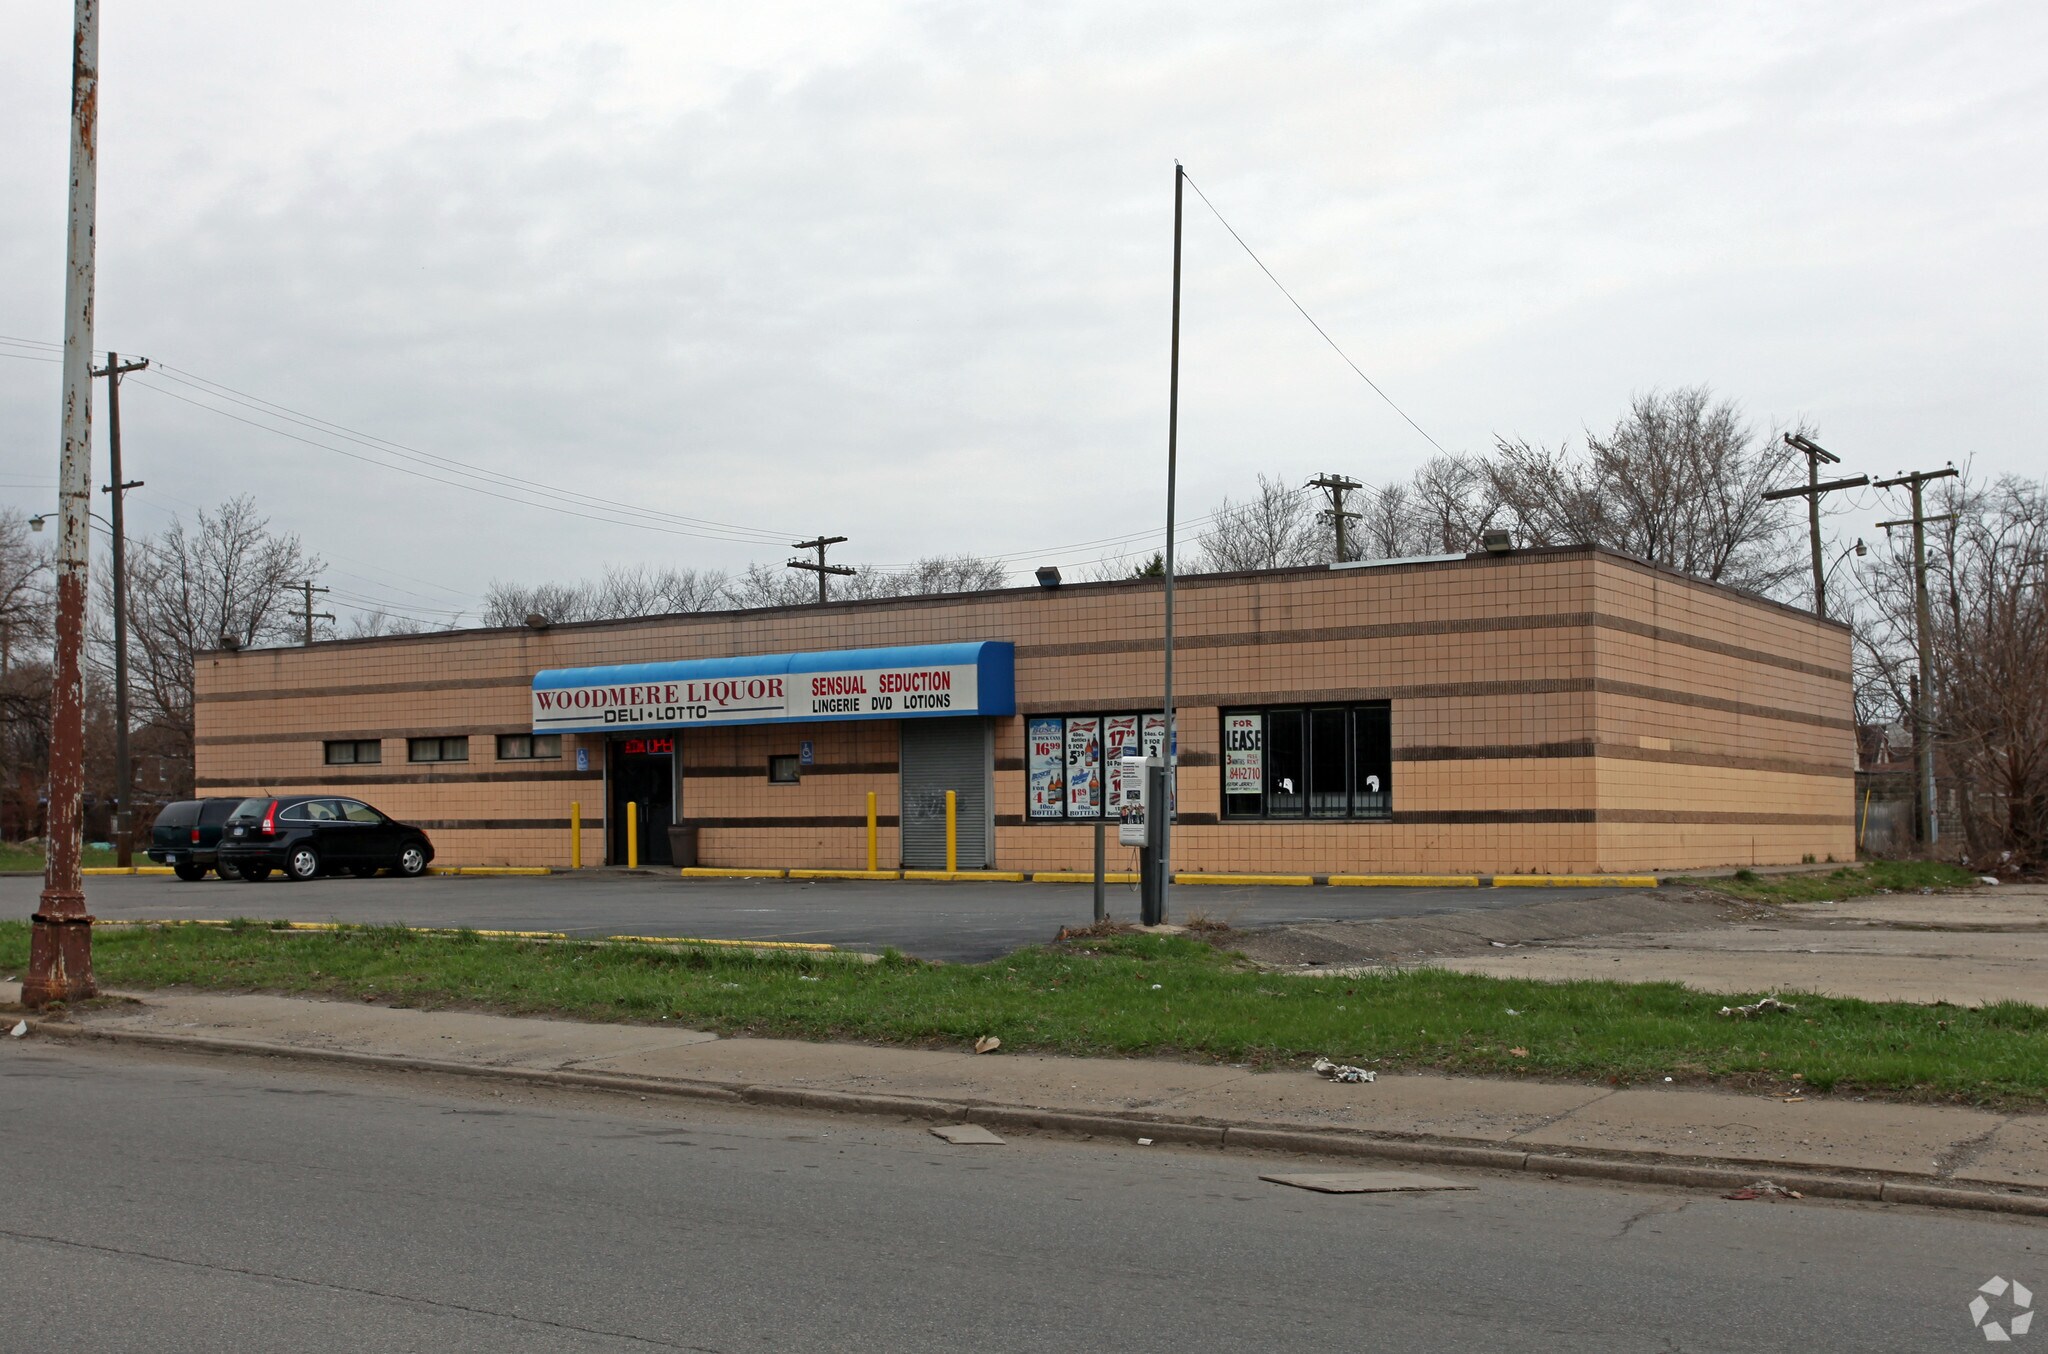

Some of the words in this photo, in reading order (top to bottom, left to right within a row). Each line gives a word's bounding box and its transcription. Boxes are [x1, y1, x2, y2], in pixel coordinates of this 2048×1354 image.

[812, 675, 867, 697] SENSUAL
[879, 671, 951, 693] SEDUCTION
[536, 684, 679, 711] WOODMERE
[686, 678, 784, 706] LIQUOR
[812, 698, 860, 713] LINGERIE
[871, 696, 893, 710] DVD
[904, 694, 951, 709] LOTIONS
[604, 709, 643, 723] DELI
[656, 705, 707, 720] LOTTO
[1226, 730, 1261, 751] LEASE
[1226, 755, 1232, 765] 3
[1230, 767, 1260, 780] 841-2710
